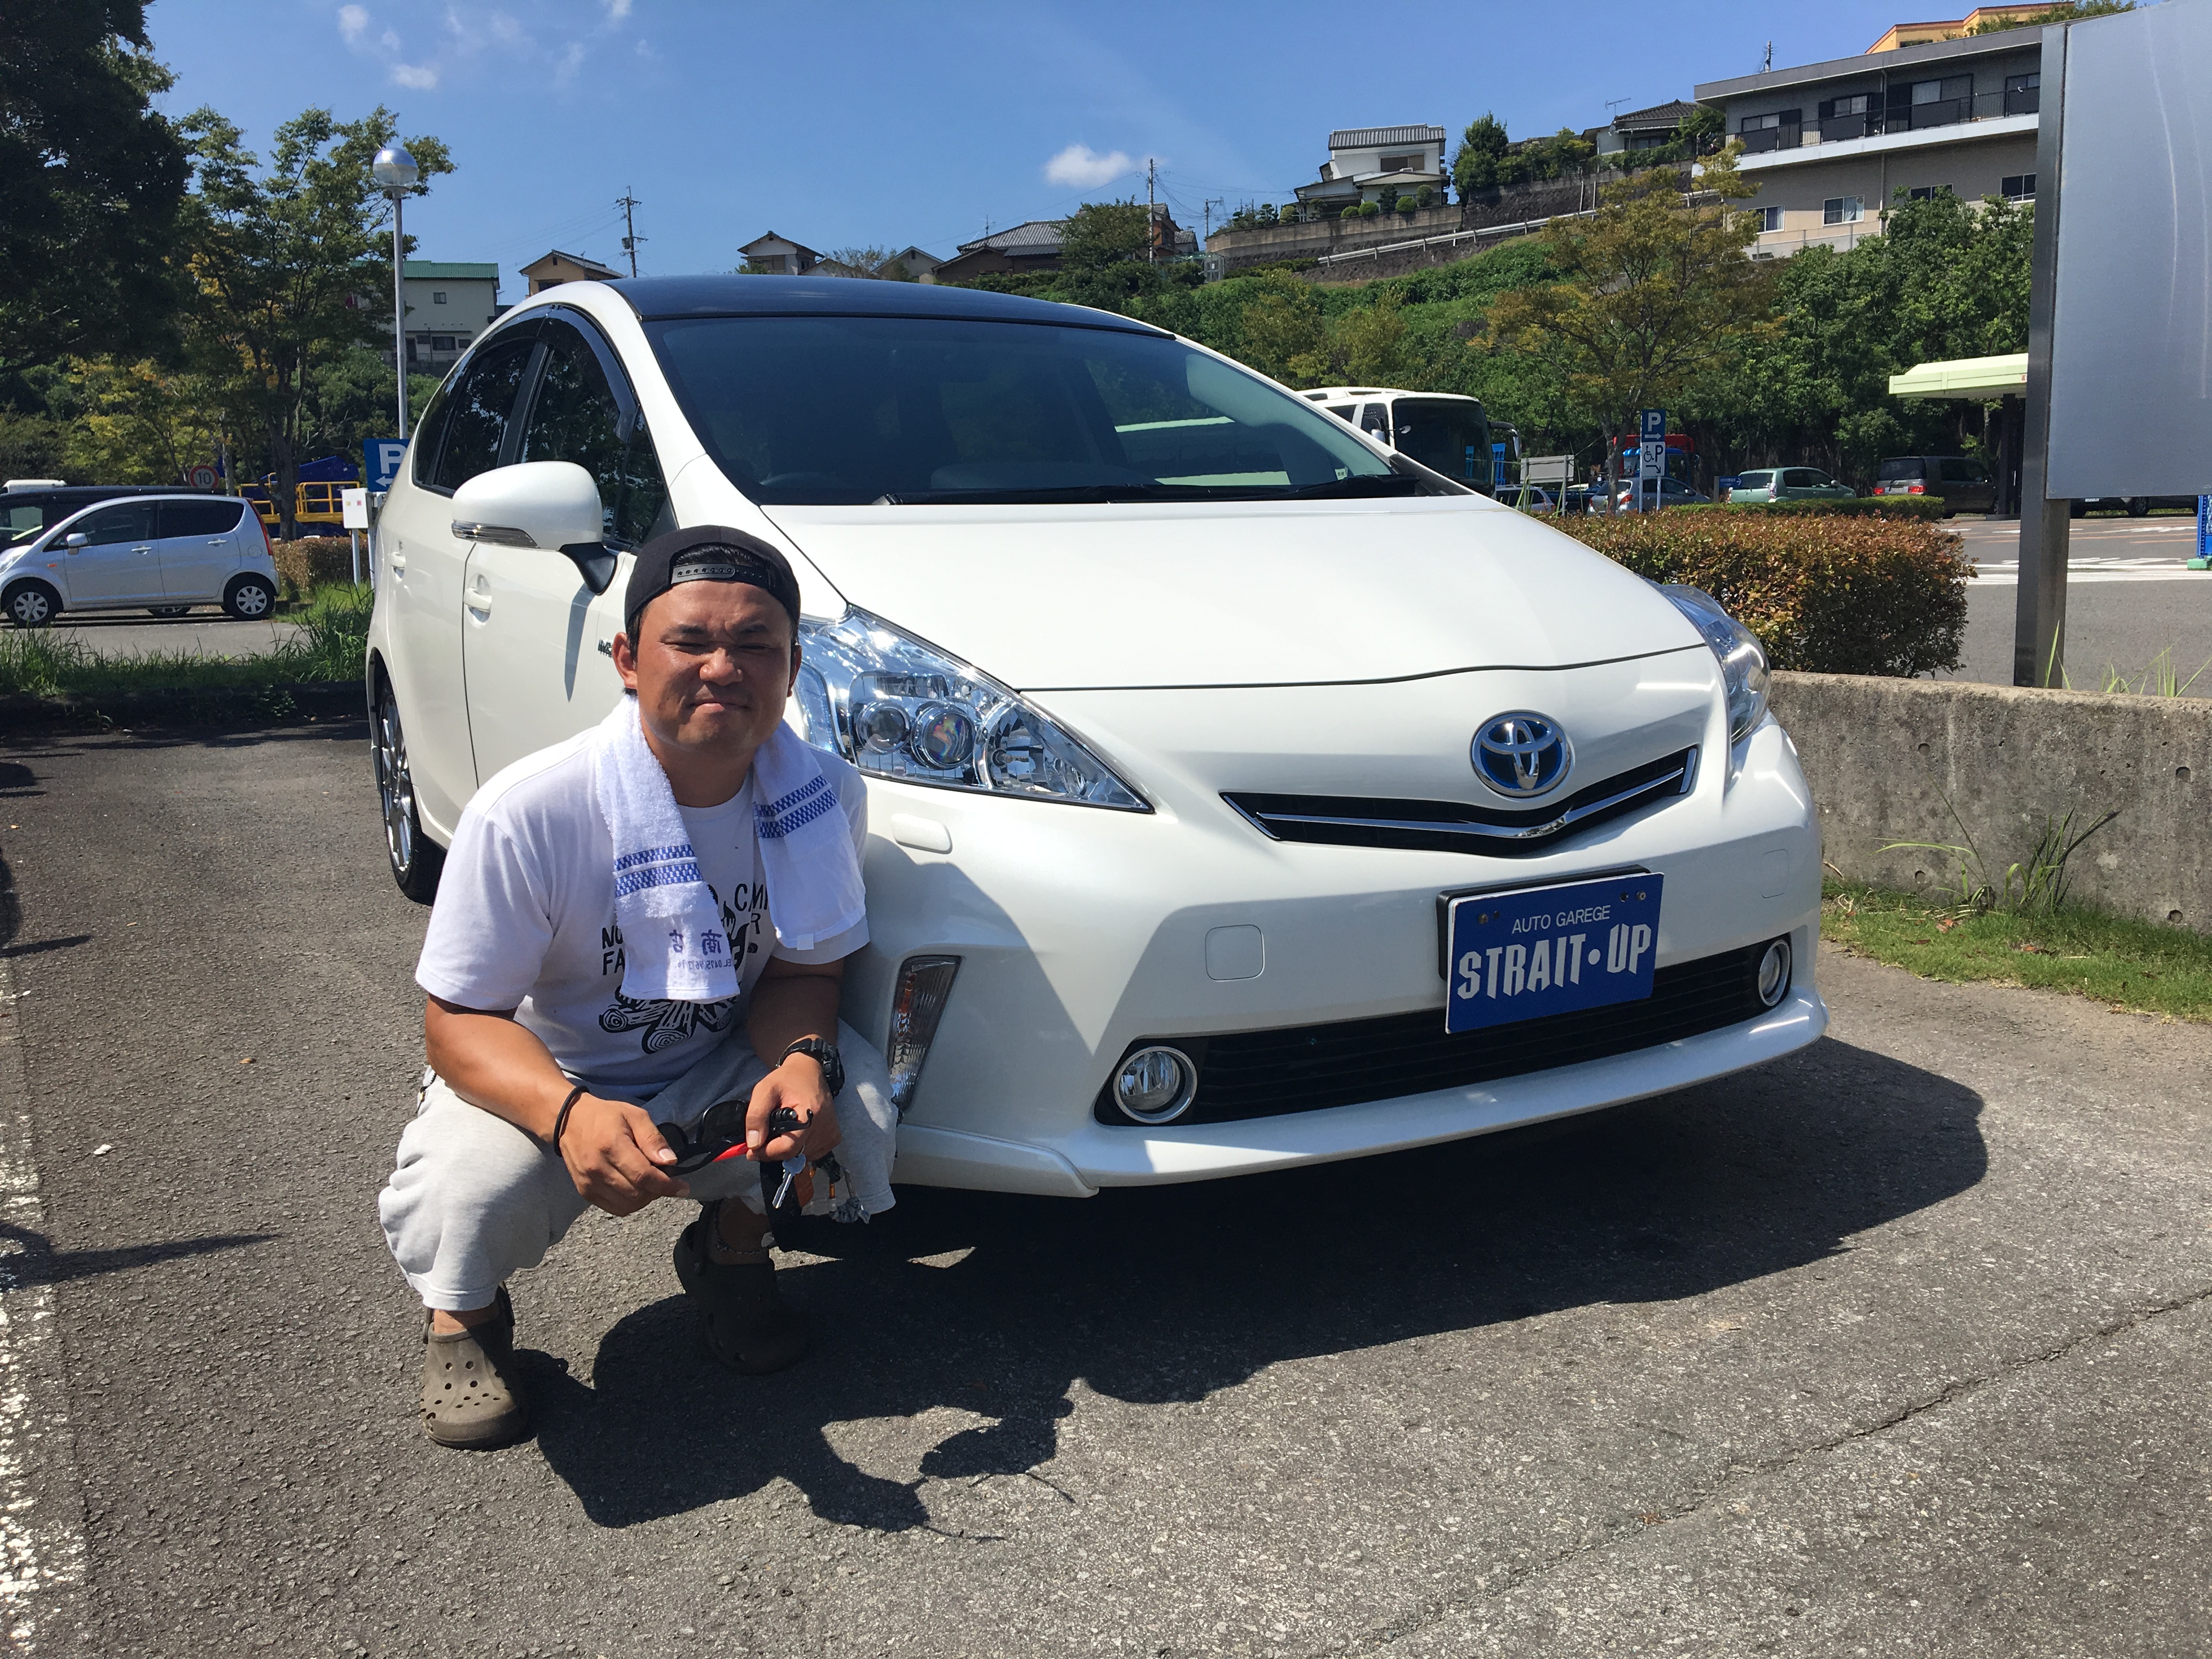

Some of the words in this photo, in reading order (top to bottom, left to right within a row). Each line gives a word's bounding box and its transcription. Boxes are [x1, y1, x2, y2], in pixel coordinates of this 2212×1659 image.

[1648, 412, 1661, 432] P
[379, 443, 407, 474] P
[1655, 444, 1664, 462] P
[198, 472, 211, 484] 10
[1511, 914, 1551, 934] AUTO
[1556, 905, 1611, 927] GAREGE
